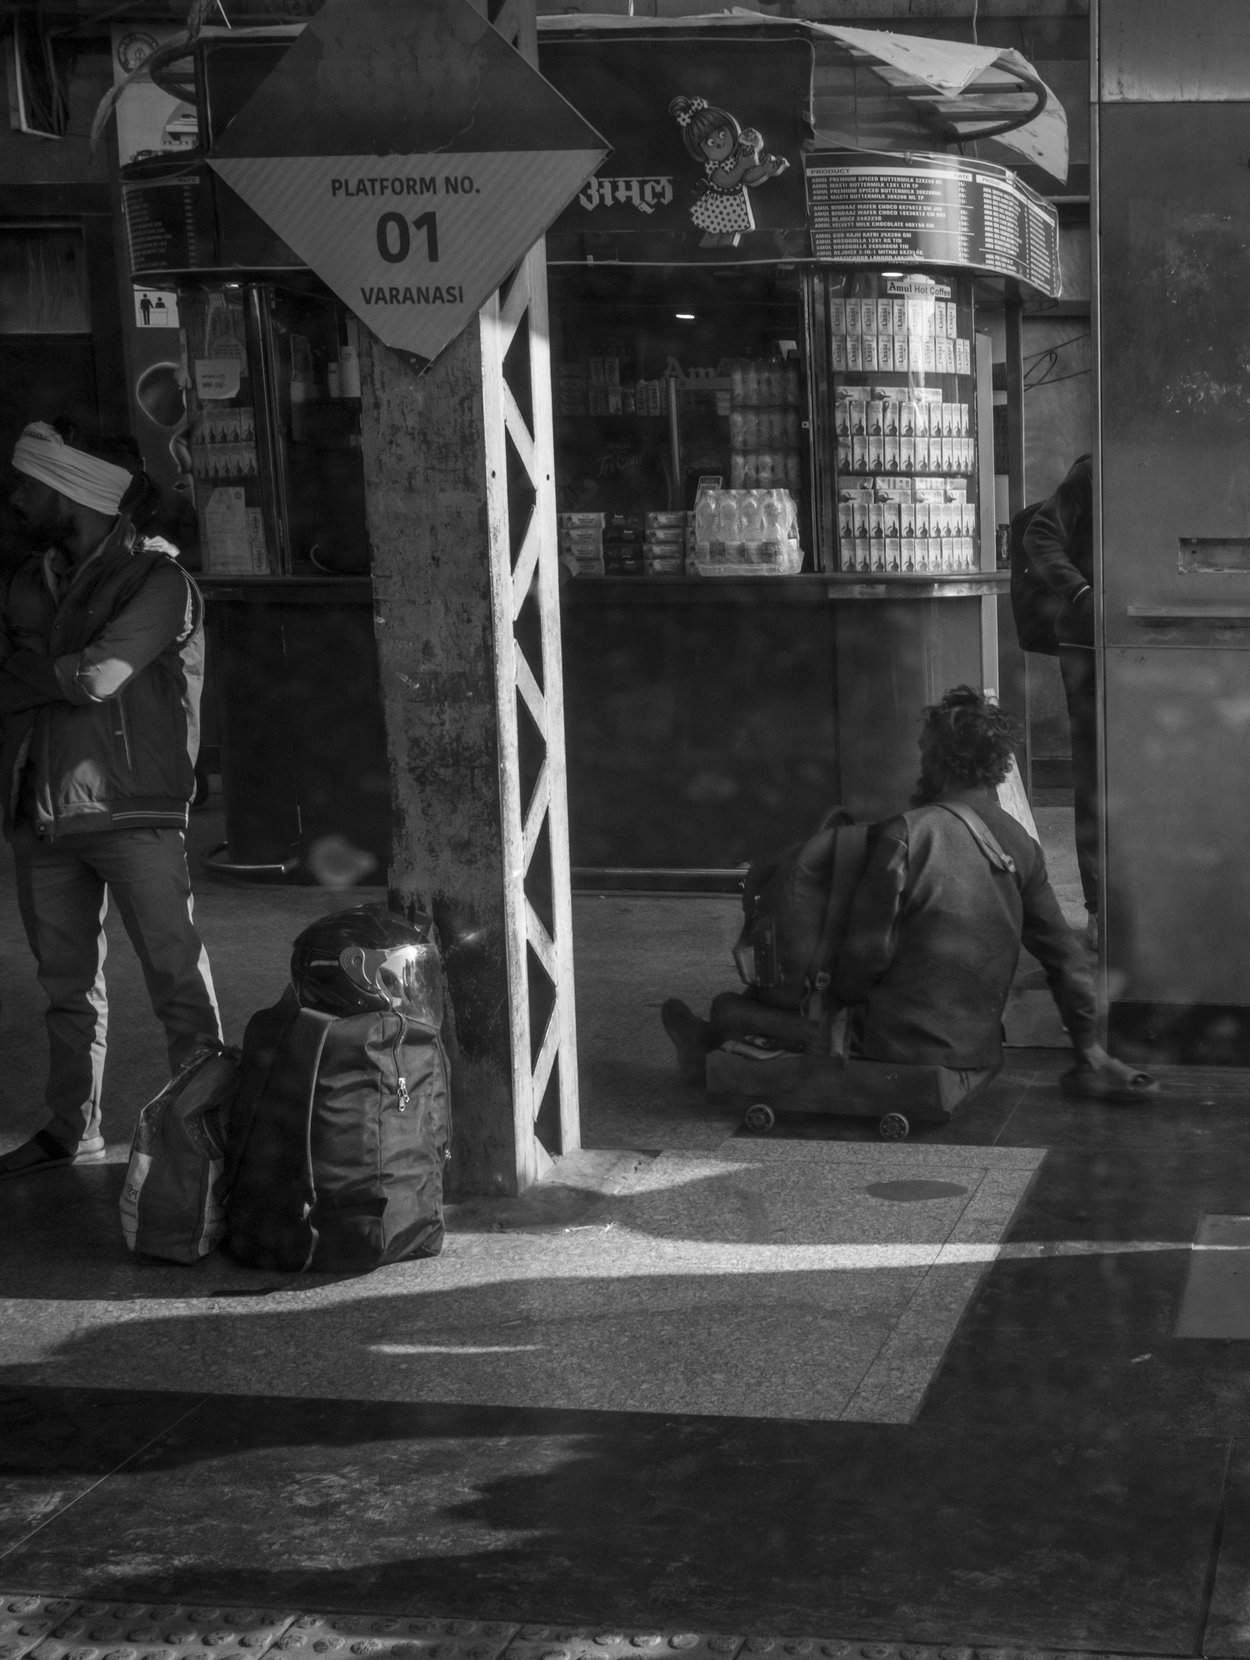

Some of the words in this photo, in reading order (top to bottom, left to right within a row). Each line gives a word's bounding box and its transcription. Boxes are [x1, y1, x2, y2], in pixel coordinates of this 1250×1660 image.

[331, 177, 439, 197] PLATFORM
[445, 176, 480, 194] NO.
[579, 175, 674, 215] अमूल
[376, 211, 440, 263] 01
[361, 285, 464, 306] VARANASI
[888, 281, 913, 293] Amul
[914, 284, 928, 294] Hot
[930, 287, 951, 297] Coffee
